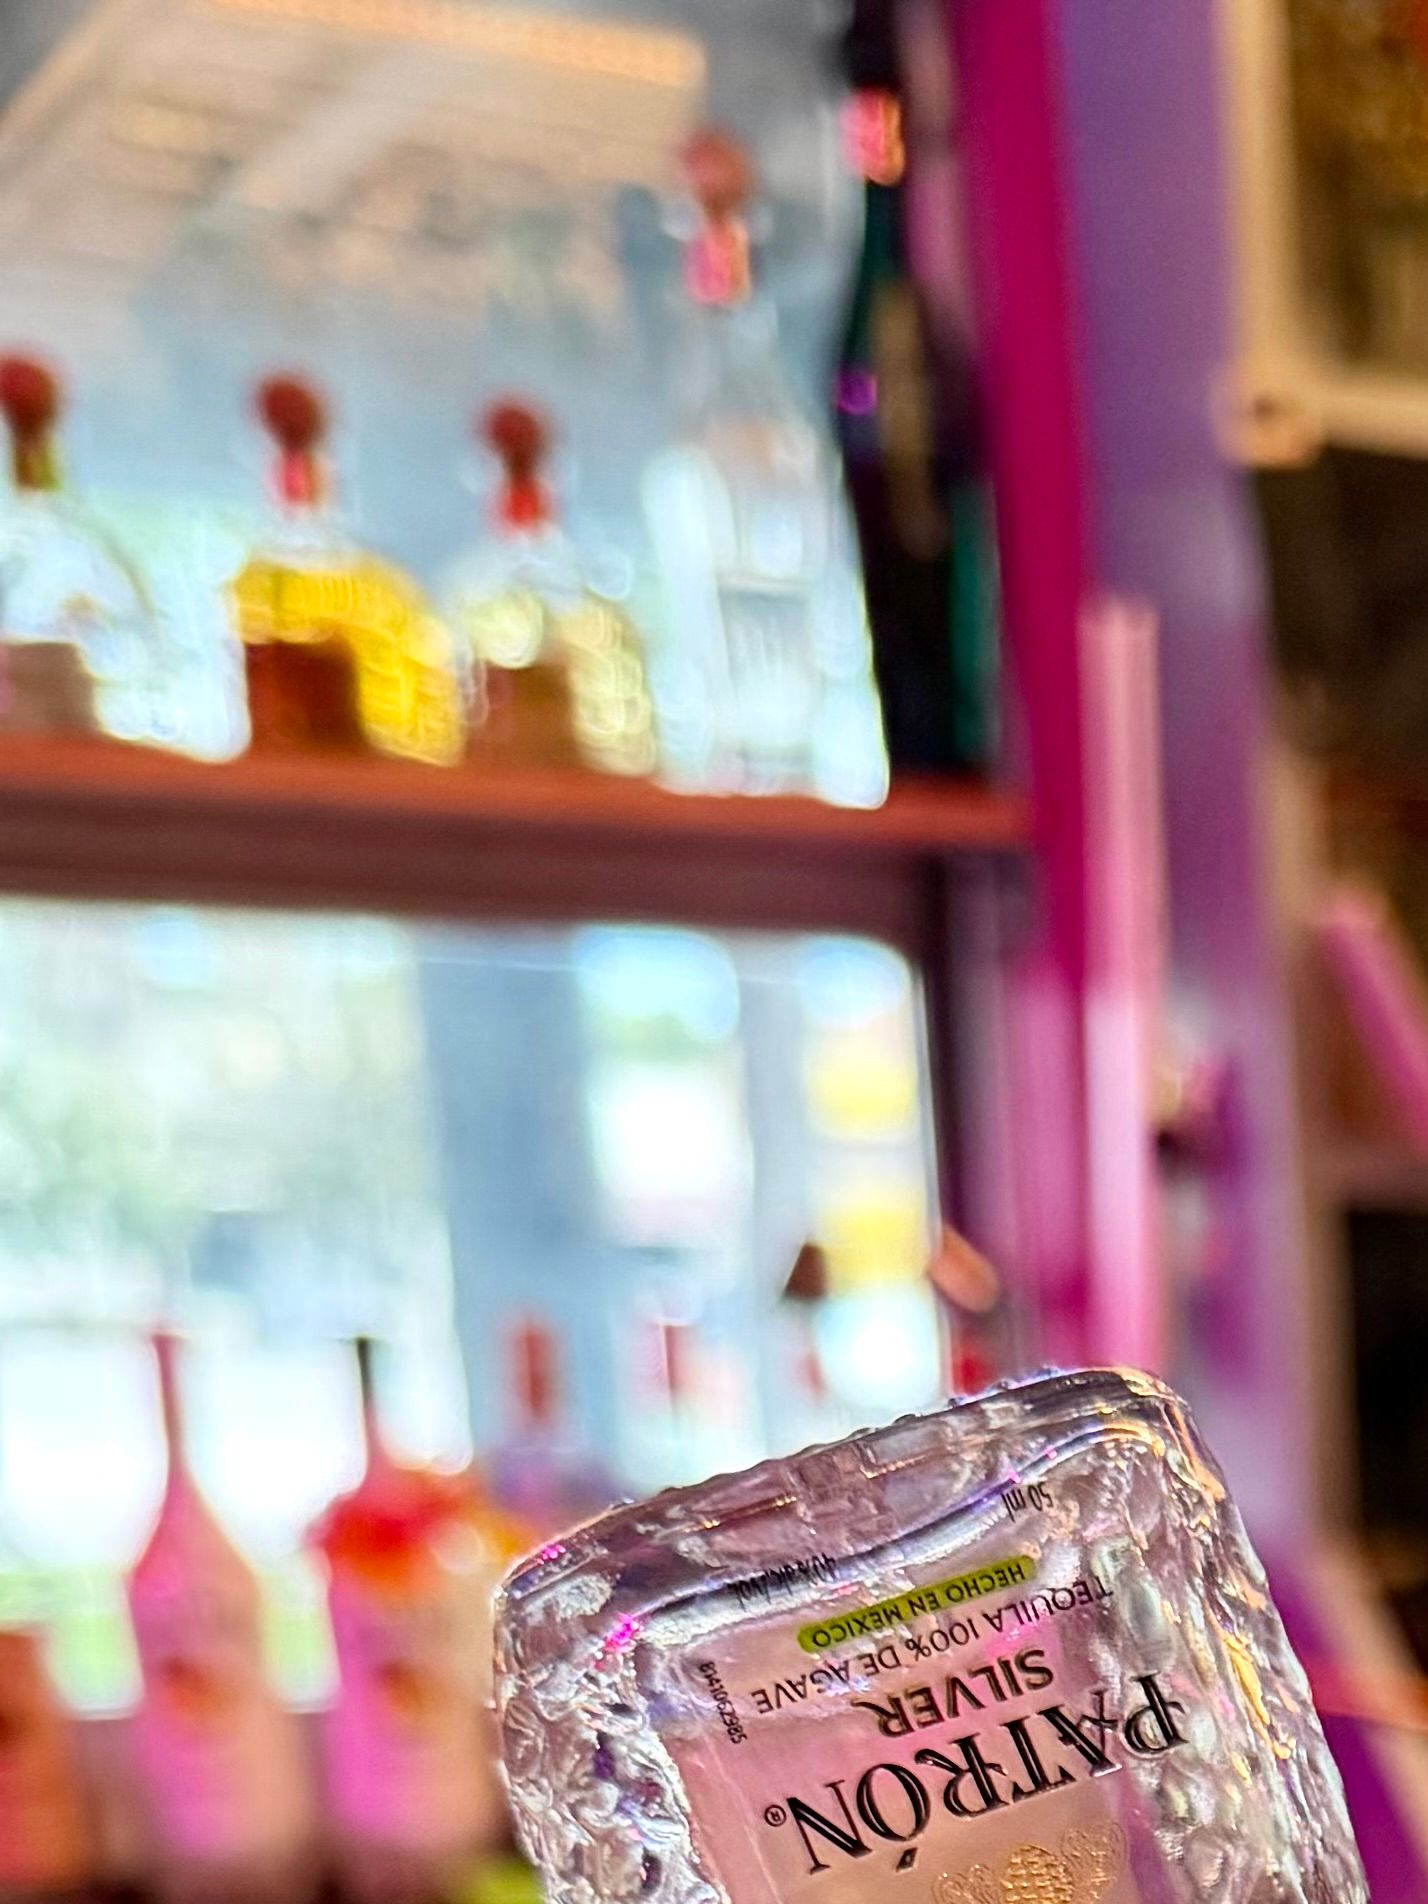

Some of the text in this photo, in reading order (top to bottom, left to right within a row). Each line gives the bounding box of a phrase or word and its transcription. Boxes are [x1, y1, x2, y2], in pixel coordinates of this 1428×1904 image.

[1003, 1481, 1054, 1522] 50 ml
[751, 1575, 1114, 1714] TEQUILA 100% DE AGAVE
[811, 1564, 1025, 1648] HECHO EN MEXICO
[852, 1649, 1053, 1738] SILVER
